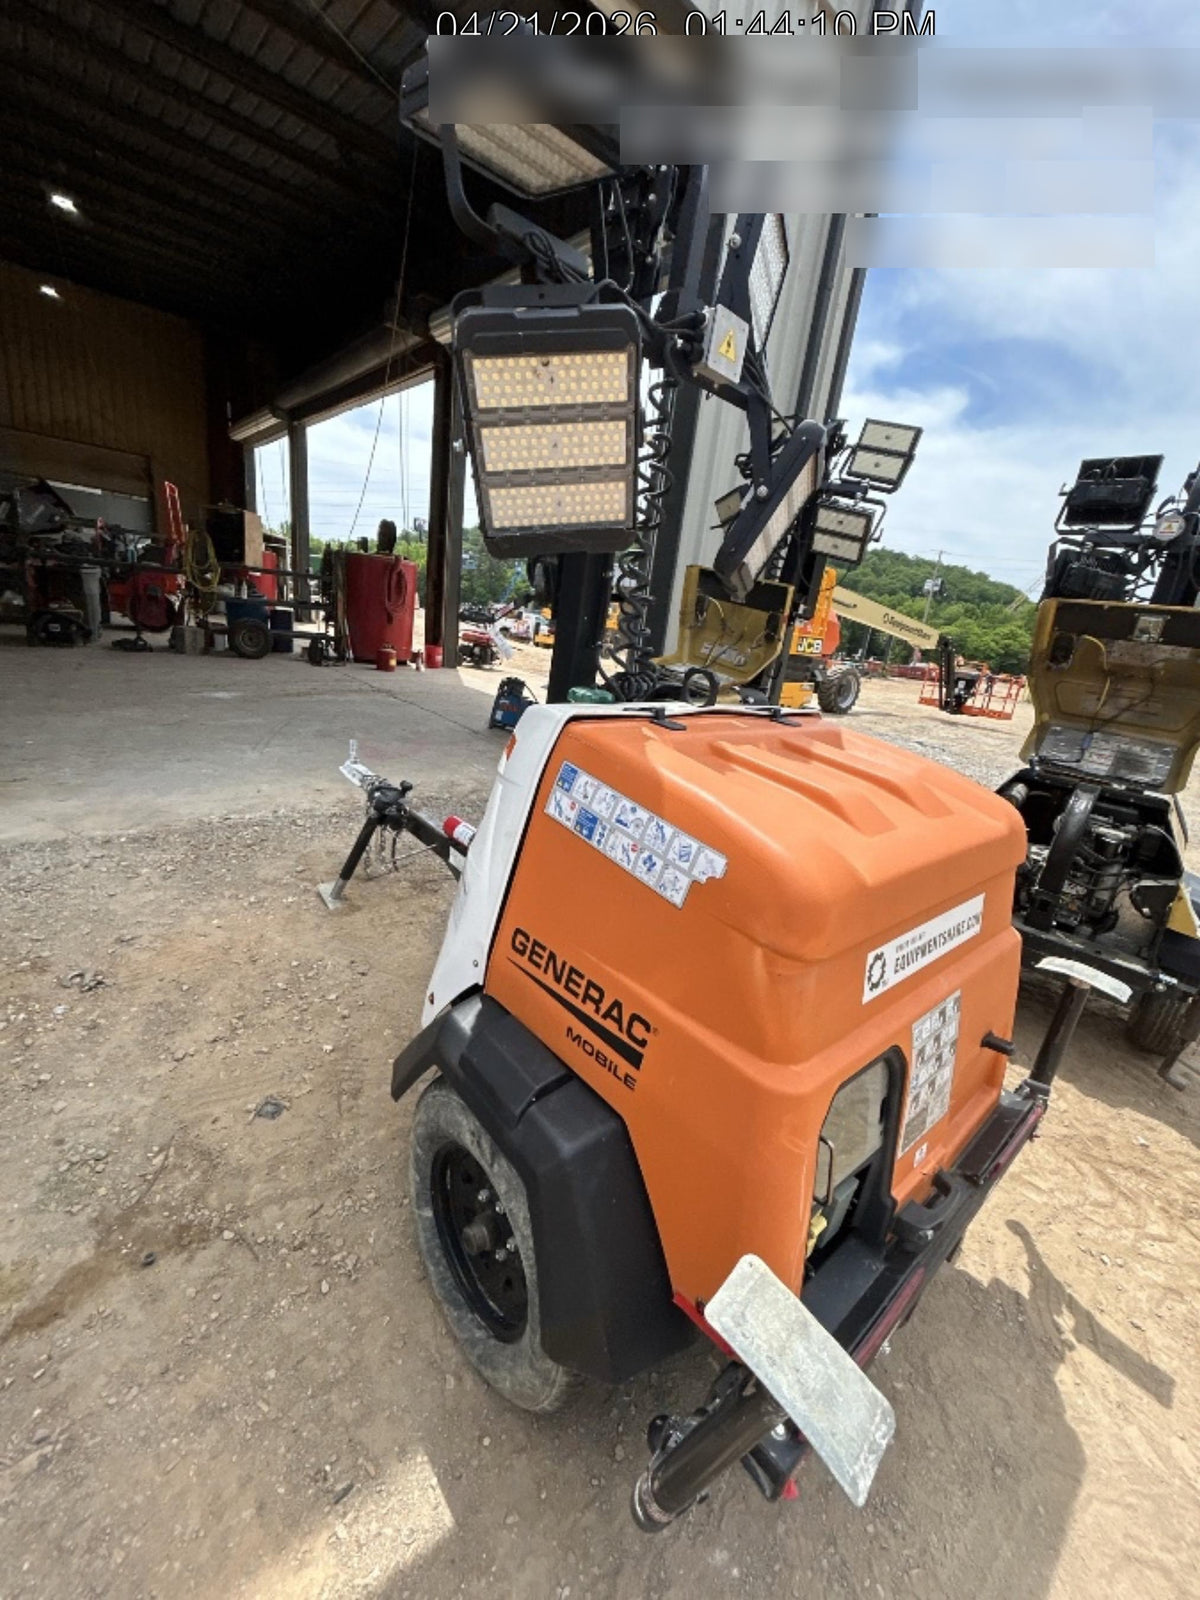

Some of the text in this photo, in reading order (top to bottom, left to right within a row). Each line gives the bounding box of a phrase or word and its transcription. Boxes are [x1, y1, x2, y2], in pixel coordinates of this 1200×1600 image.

[797, 637, 823, 654] JCB
[511, 927, 652, 1050] GENERAC
[566, 1026, 638, 1092] MOBILE
